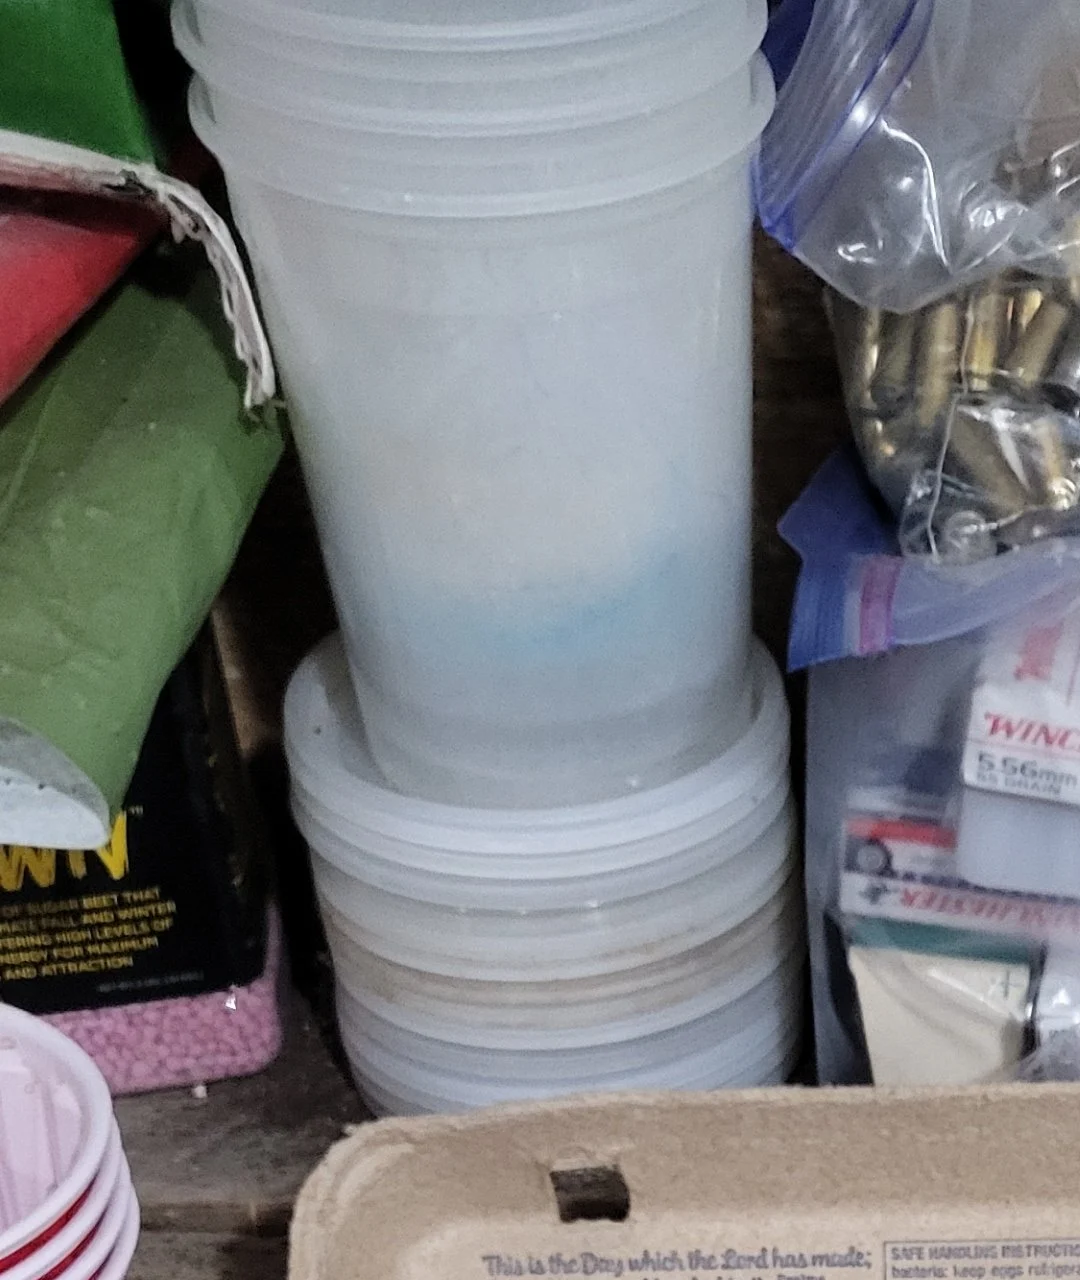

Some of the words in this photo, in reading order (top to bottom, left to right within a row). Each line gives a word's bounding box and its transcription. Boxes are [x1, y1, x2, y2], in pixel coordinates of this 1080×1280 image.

[482, 1254, 524, 1276] This
[528, 1256, 546, 1276] is
[548, 1252, 580, 1275] the
[580, 1251, 624, 1277] Day
[628, 1250, 685, 1272] which
[687, 1248, 717, 1271] the
[720, 1246, 770, 1270] Lord
[771, 1246, 809, 1269] has
